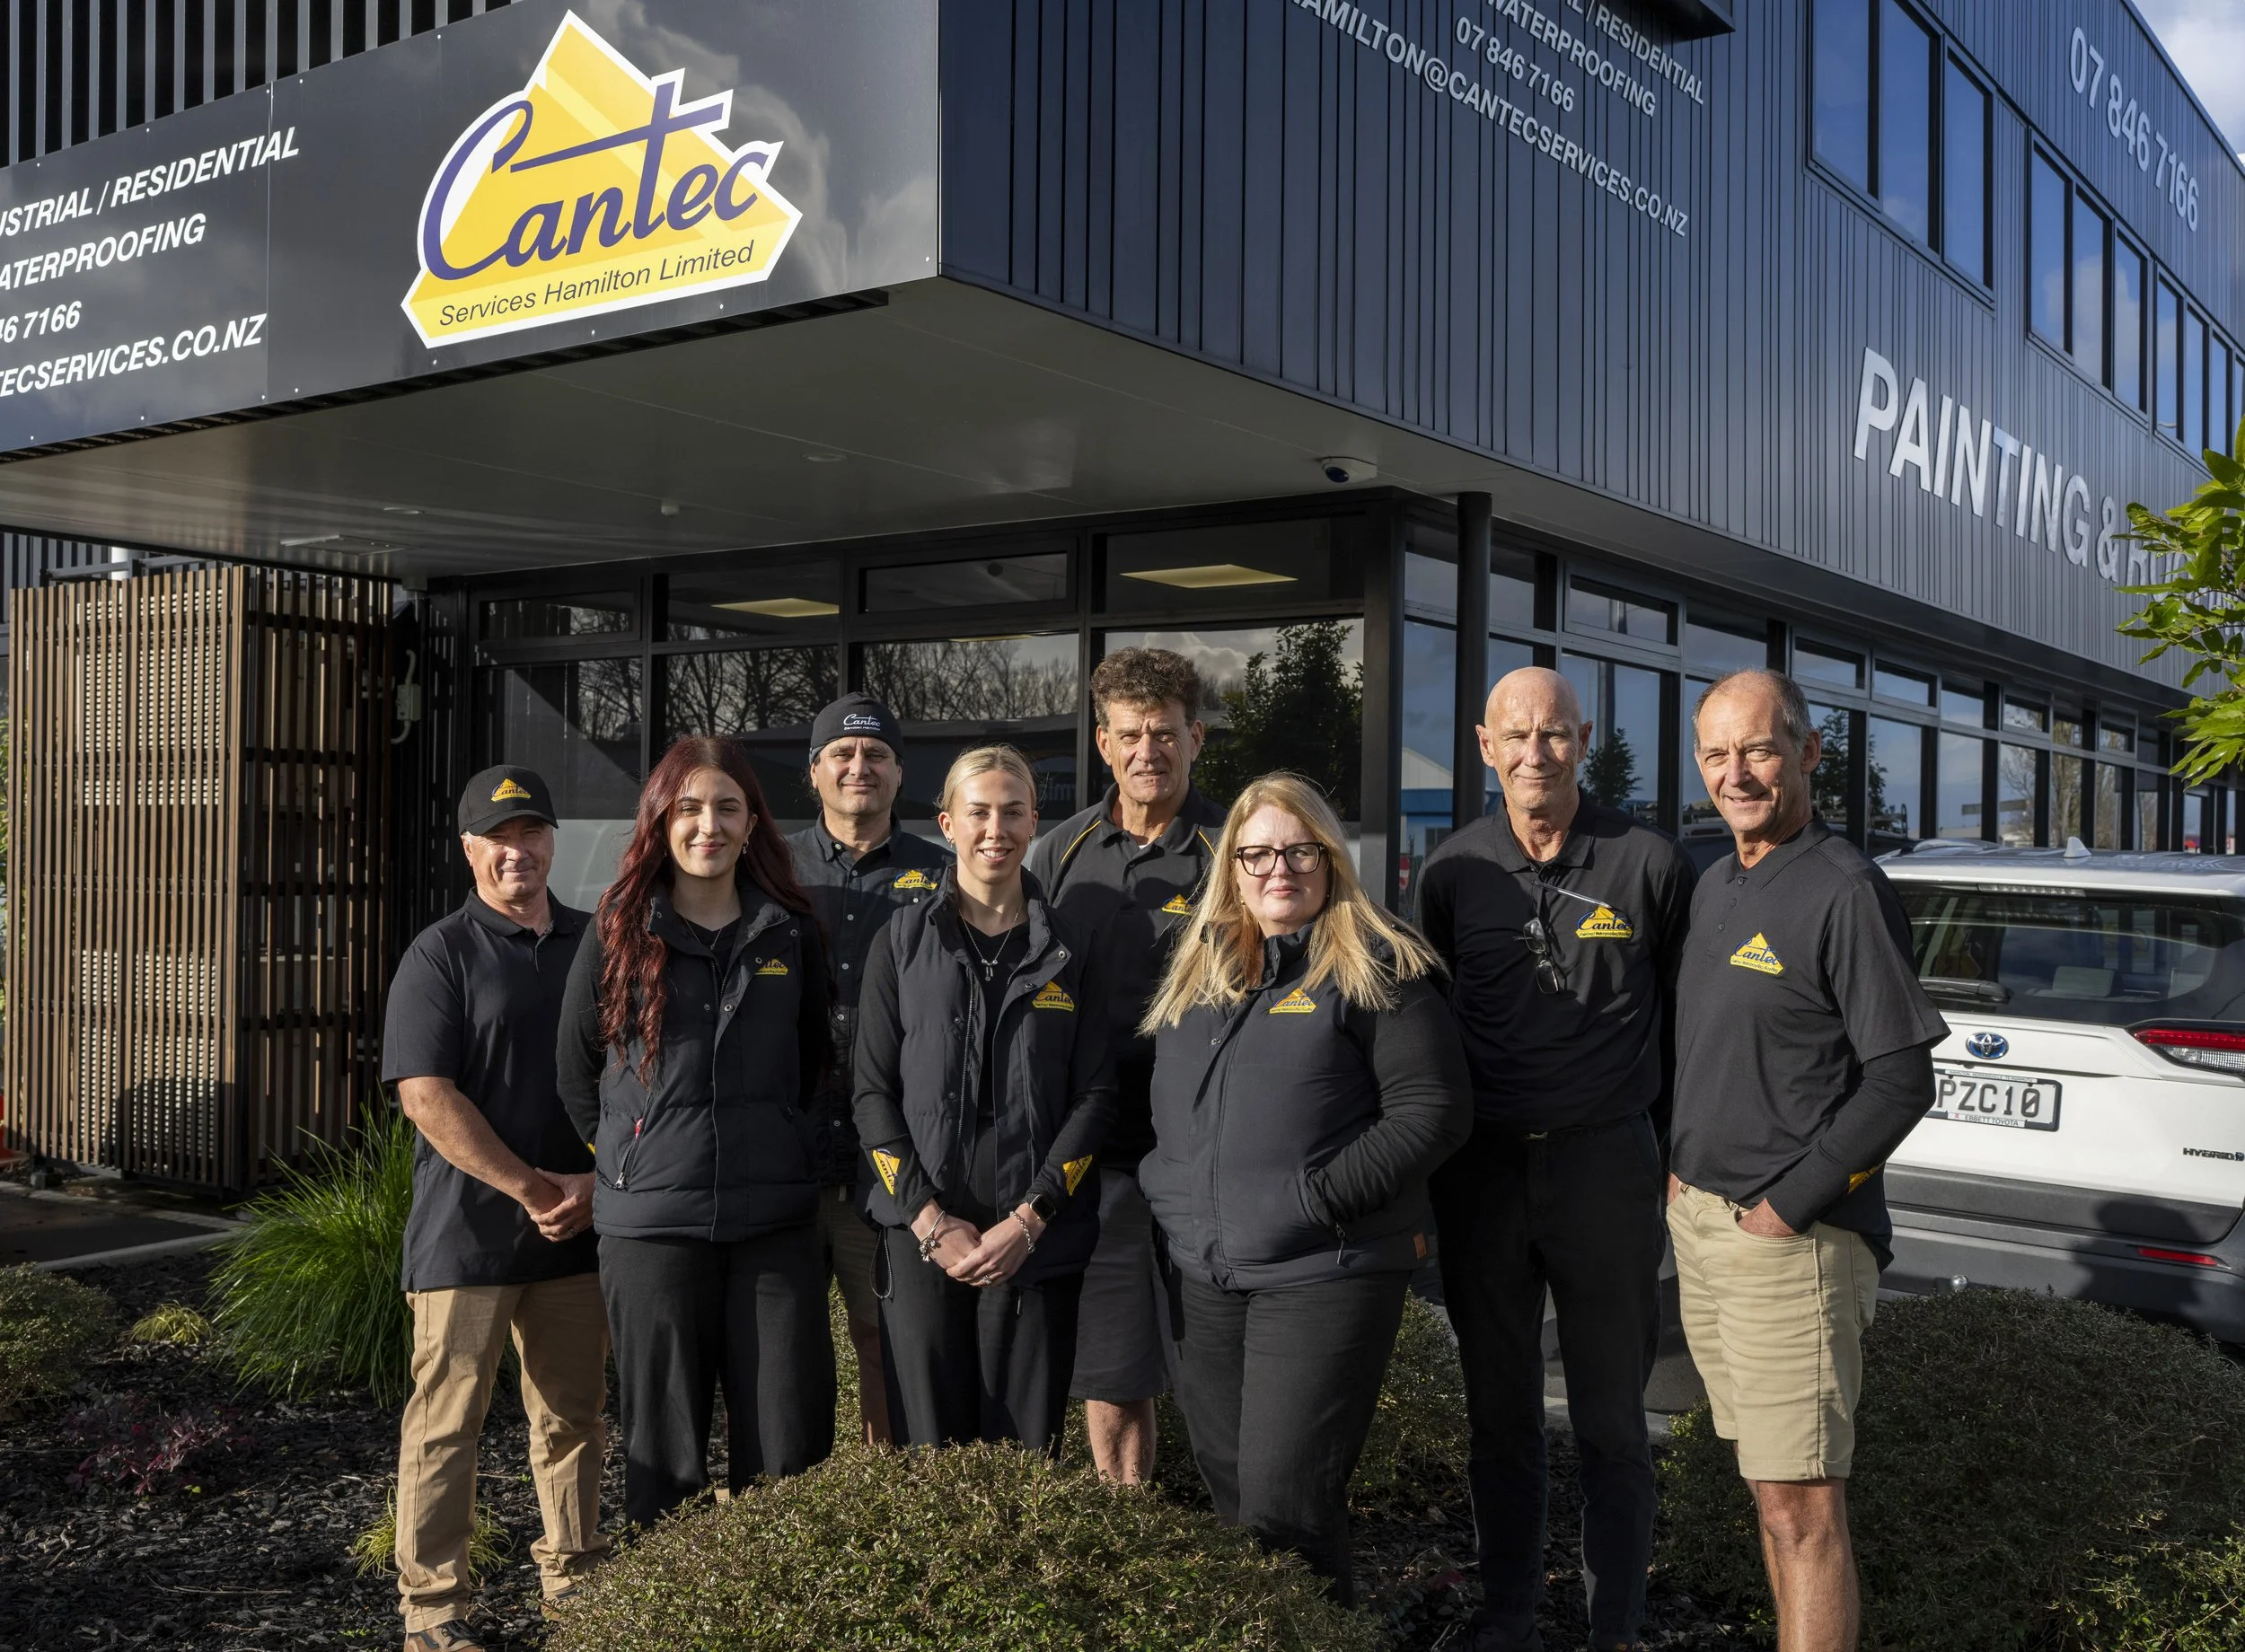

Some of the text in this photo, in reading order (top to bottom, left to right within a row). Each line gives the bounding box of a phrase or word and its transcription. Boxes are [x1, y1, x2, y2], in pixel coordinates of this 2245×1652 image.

[1457, 17, 1574, 112] 07 846 7166
[1595, 4, 1704, 105] RESIDENTIAL
[110, 127, 299, 208] RESIDENTIAL
[2070, 28, 2198, 232] 07 846 7166
[423, 81, 769, 280] Cantec
[23, 301, 82, 338] 7166
[440, 239, 754, 326] Services Hamilton Limited
[0, 313, 267, 397] ECSERVICES.CO.NZ
[1853, 347, 2091, 567] PAINTING
[2096, 496, 2118, 583] &
[843, 713, 881, 726] Cantec
[1578, 911, 1632, 930] Cantec
[1734, 938, 1782, 965] Cantec
[1937, 1079, 2040, 1118] PZC10
[1992, 1117, 2019, 1127] TOYOTA
[2183, 1147, 2234, 1160] HYBRID
